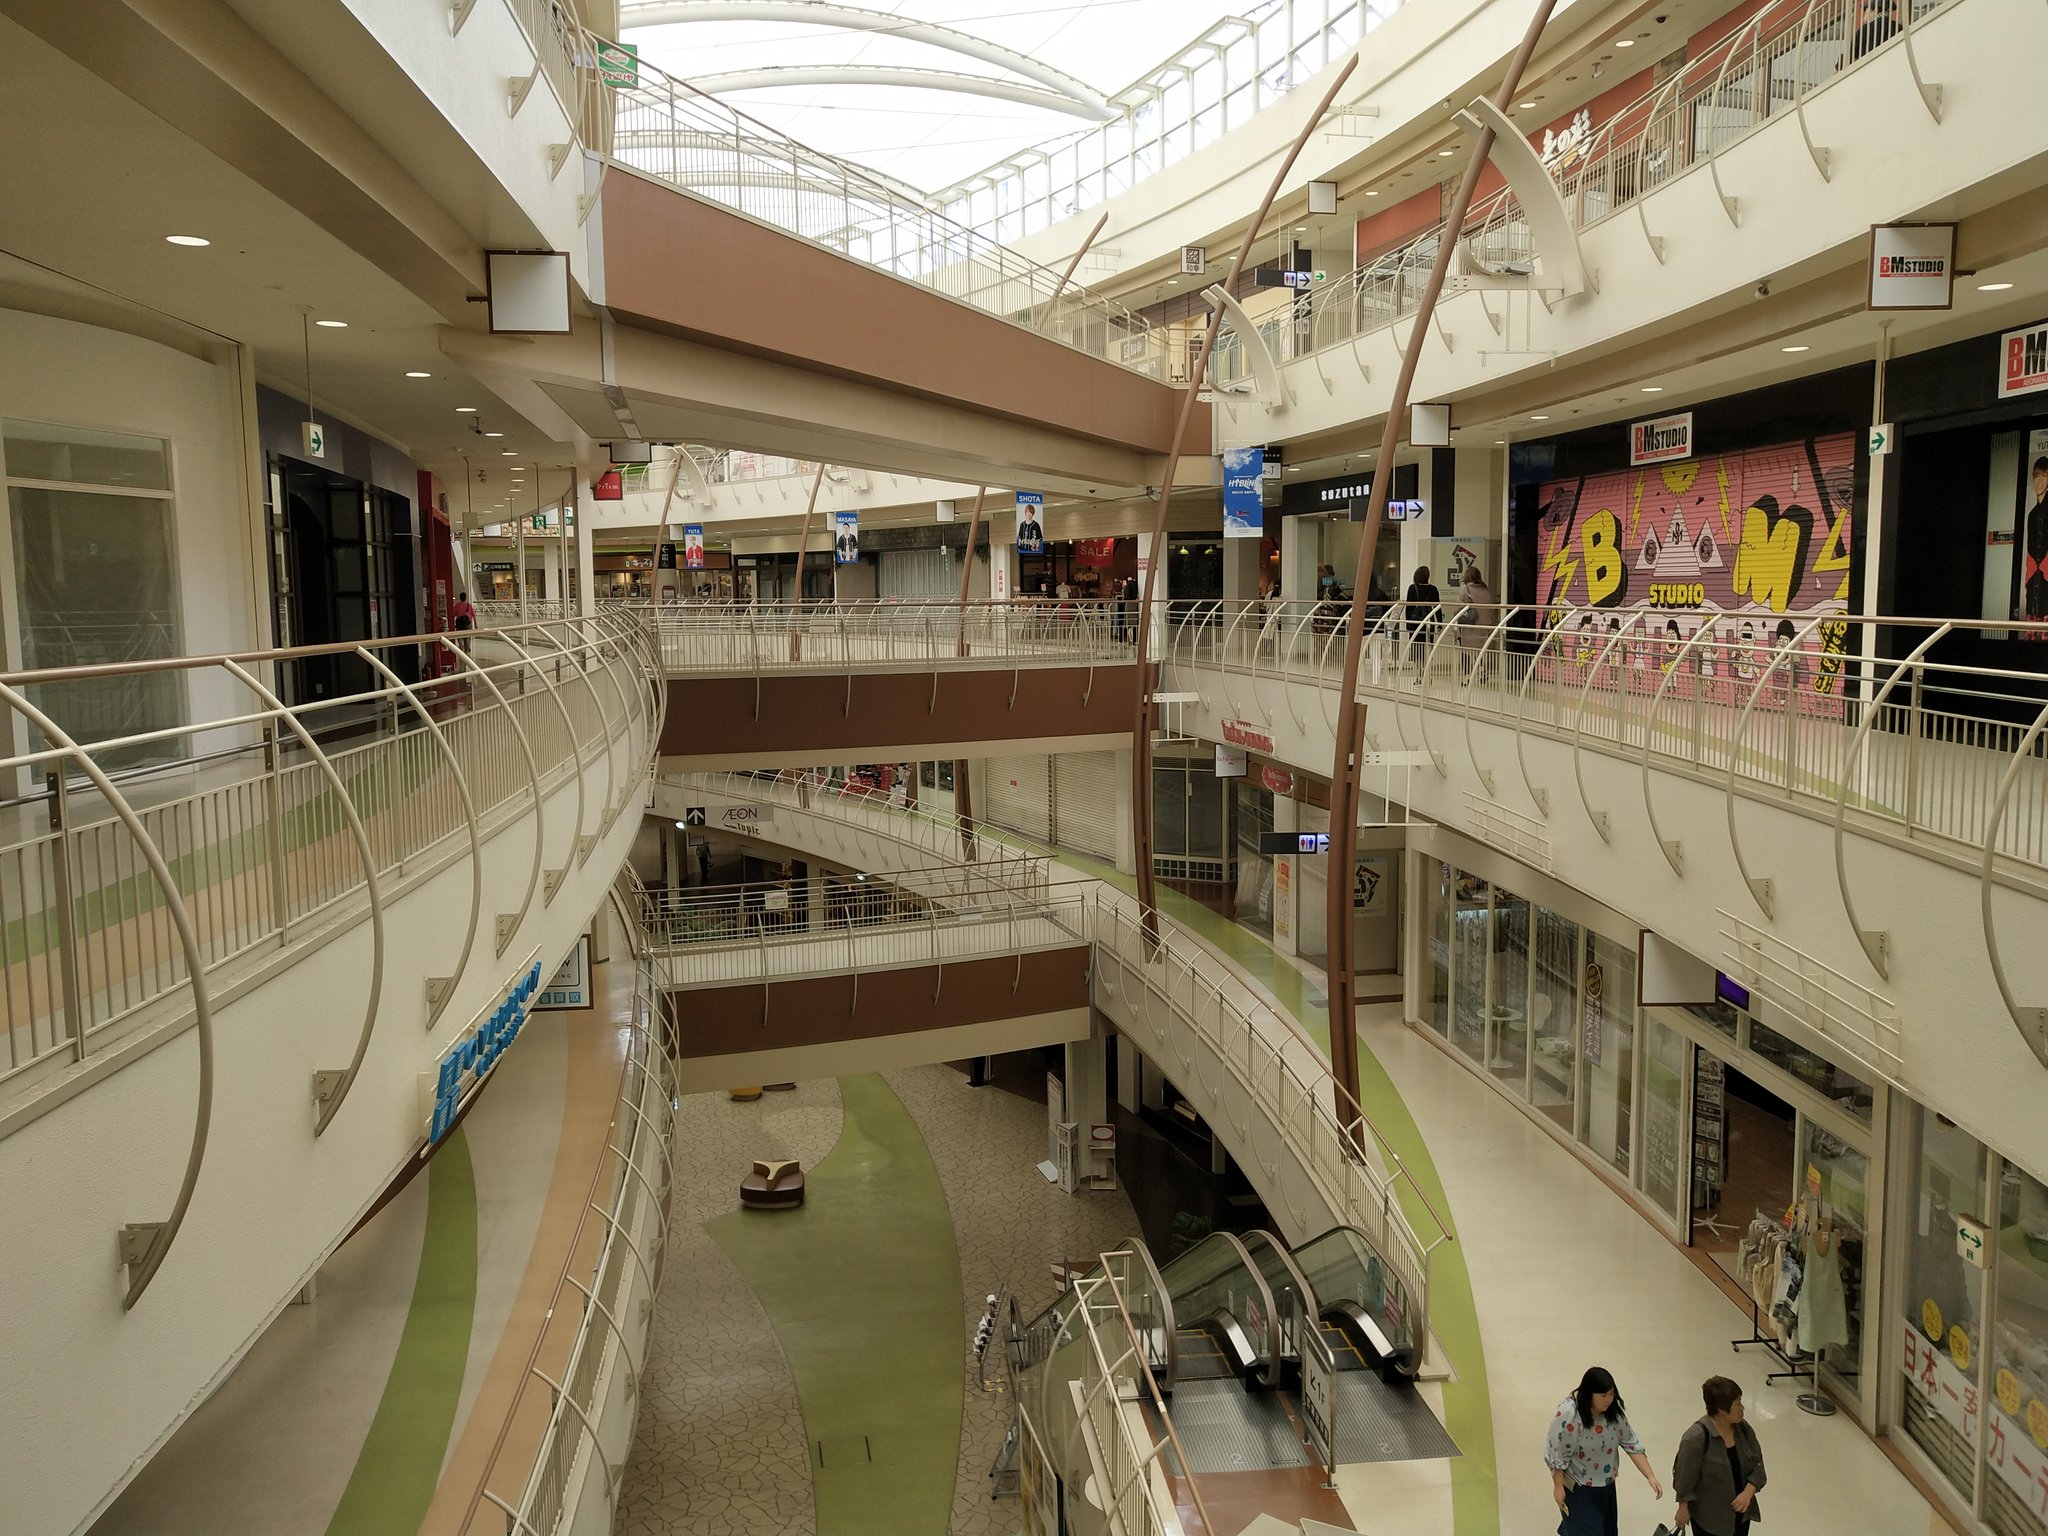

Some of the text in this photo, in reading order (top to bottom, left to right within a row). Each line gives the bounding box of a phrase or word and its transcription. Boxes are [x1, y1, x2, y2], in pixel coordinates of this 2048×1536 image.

[1018, 495, 1041, 503] SHOTA
[1321, 484, 1370, 501] suzutan
[1080, 545, 1110, 557] SALE
[1650, 583, 1705, 608] STUDIO
